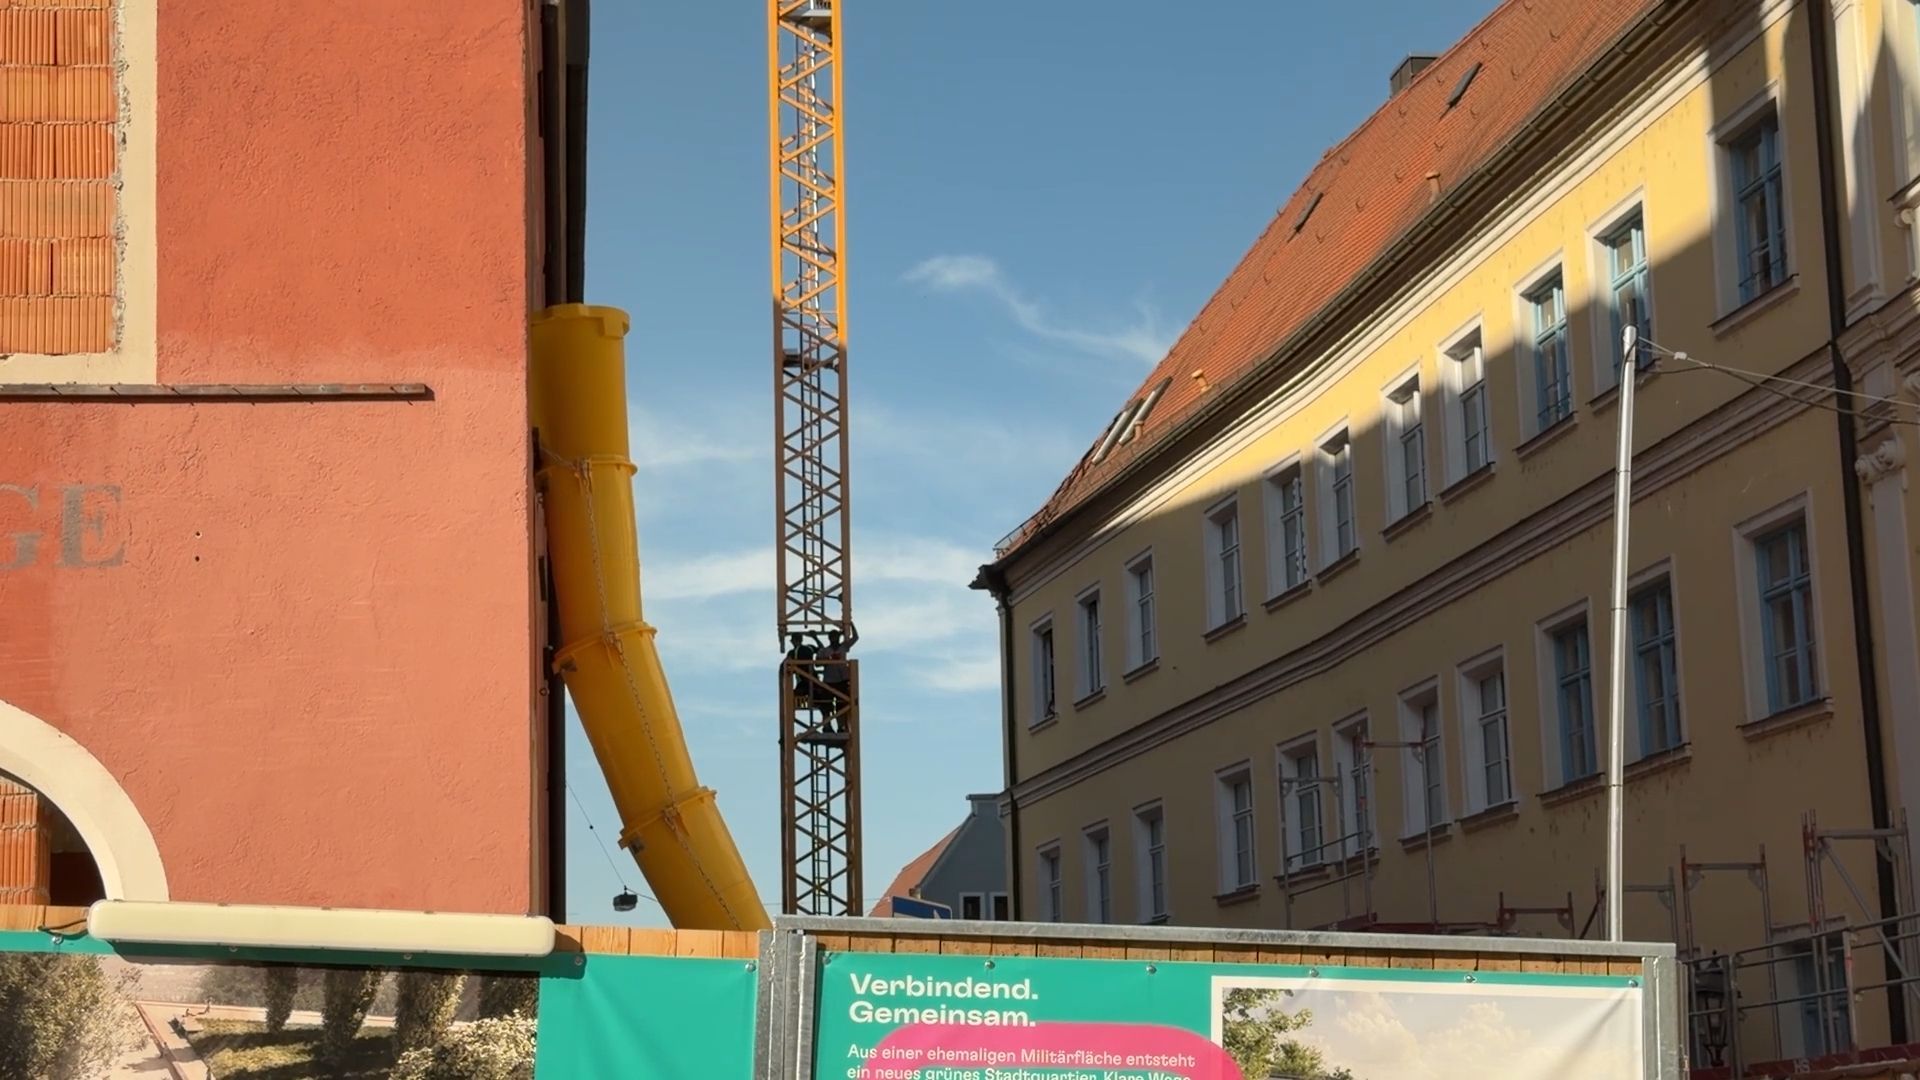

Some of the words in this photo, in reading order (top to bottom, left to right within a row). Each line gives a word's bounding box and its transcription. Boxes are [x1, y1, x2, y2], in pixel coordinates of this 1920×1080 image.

[849, 973, 1039, 1000] Verbindend.
[849, 1000, 1037, 1027] Gemeinsam.
[847, 1044, 878, 1059] Aus
[881, 1046, 923, 1060] einer
[927, 1047, 1016, 1065] ehemaligen
[1020, 1049, 1123, 1066] Militärfläche
[1125, 1053, 1196, 1068] entsteht
[847, 1065, 870, 1079] ein
[875, 1067, 921, 1080] neues
[925, 1067, 980, 1080] grünes
